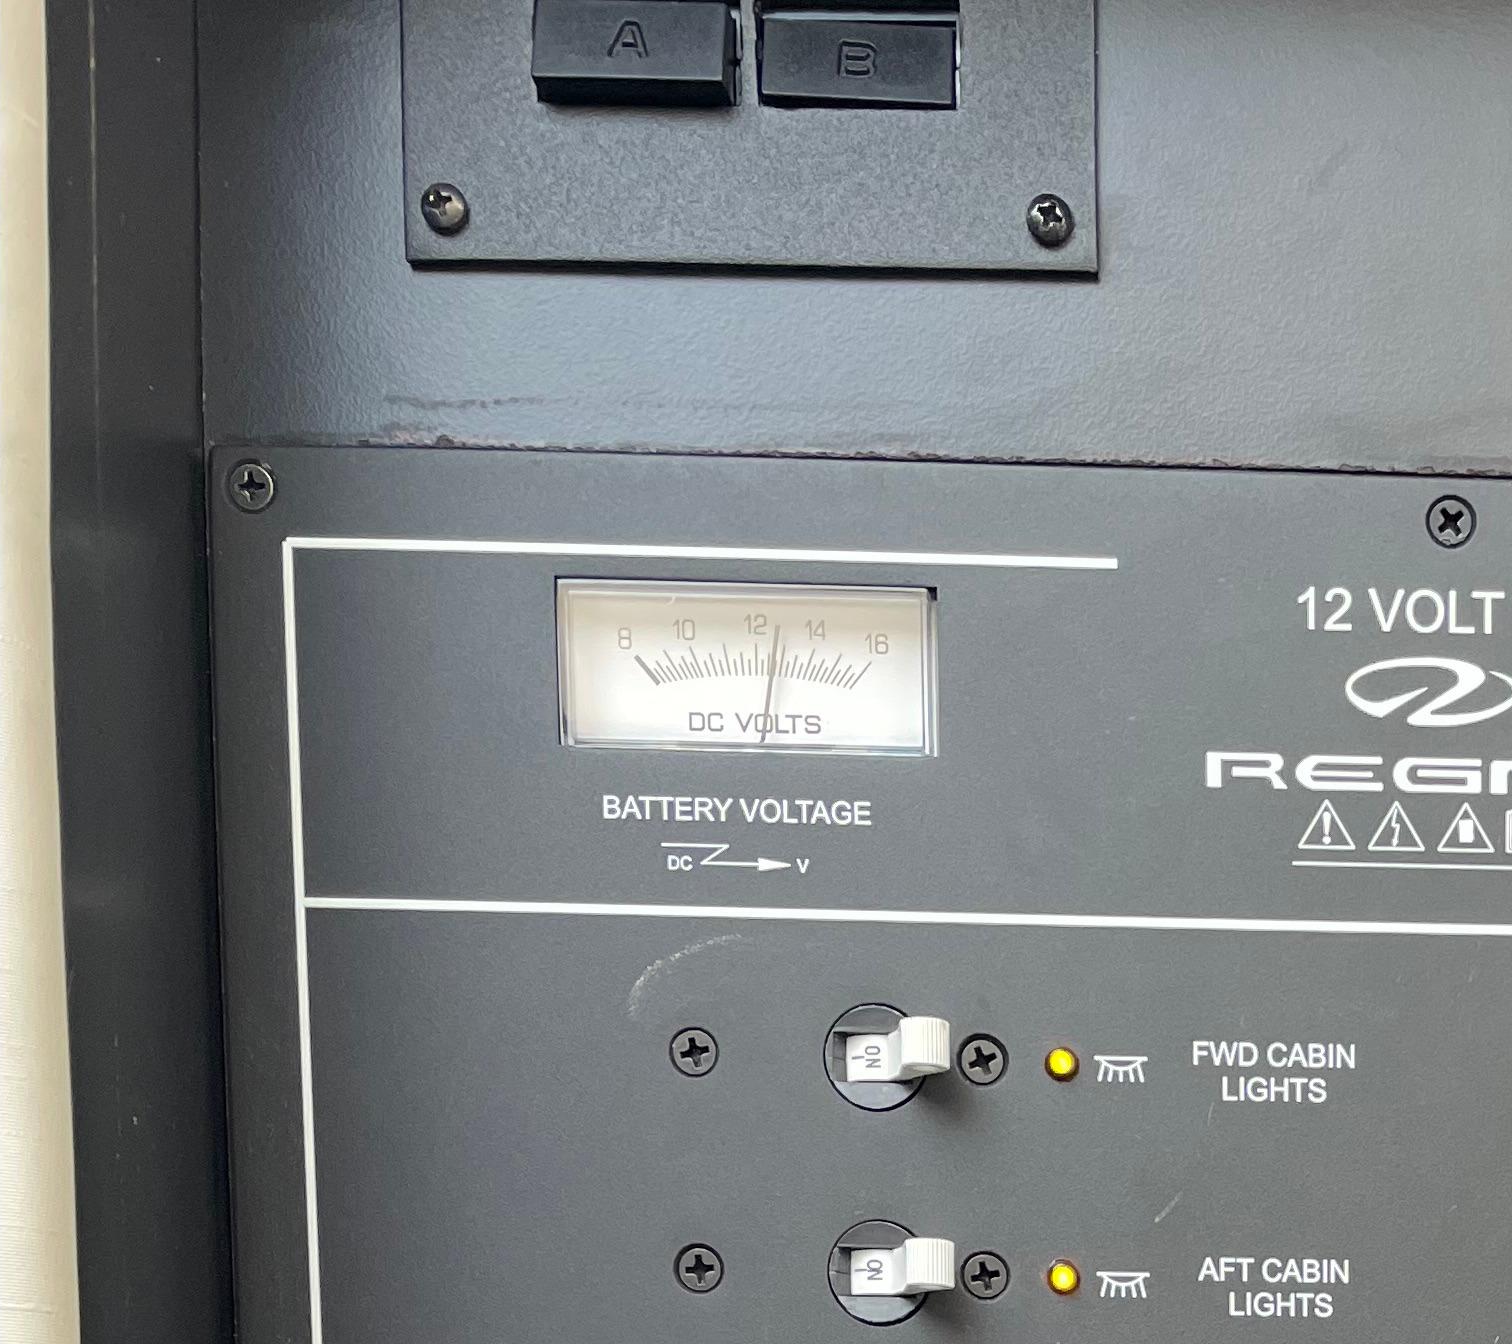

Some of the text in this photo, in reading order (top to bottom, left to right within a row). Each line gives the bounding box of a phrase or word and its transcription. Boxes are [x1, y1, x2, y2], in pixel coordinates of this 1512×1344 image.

[607, 19, 649, 58] A
[837, 39, 876, 79] B
[1297, 586, 1353, 632] 12
[1367, 587, 1506, 635] VOLT
[618, 614, 889, 655] 8 10 12 14 16
[689, 712, 821, 734] DC VOLTS
[602, 794, 872, 826] BATTERY VOLTAGE
[667, 854, 810, 874] DC V
[1192, 1040, 1356, 1069] FWD CABIN
[1221, 1075, 1328, 1104] LIGHTS
[1197, 1256, 1350, 1284] AFT CABIN
[1228, 1291, 1334, 1318] LIGHTS
